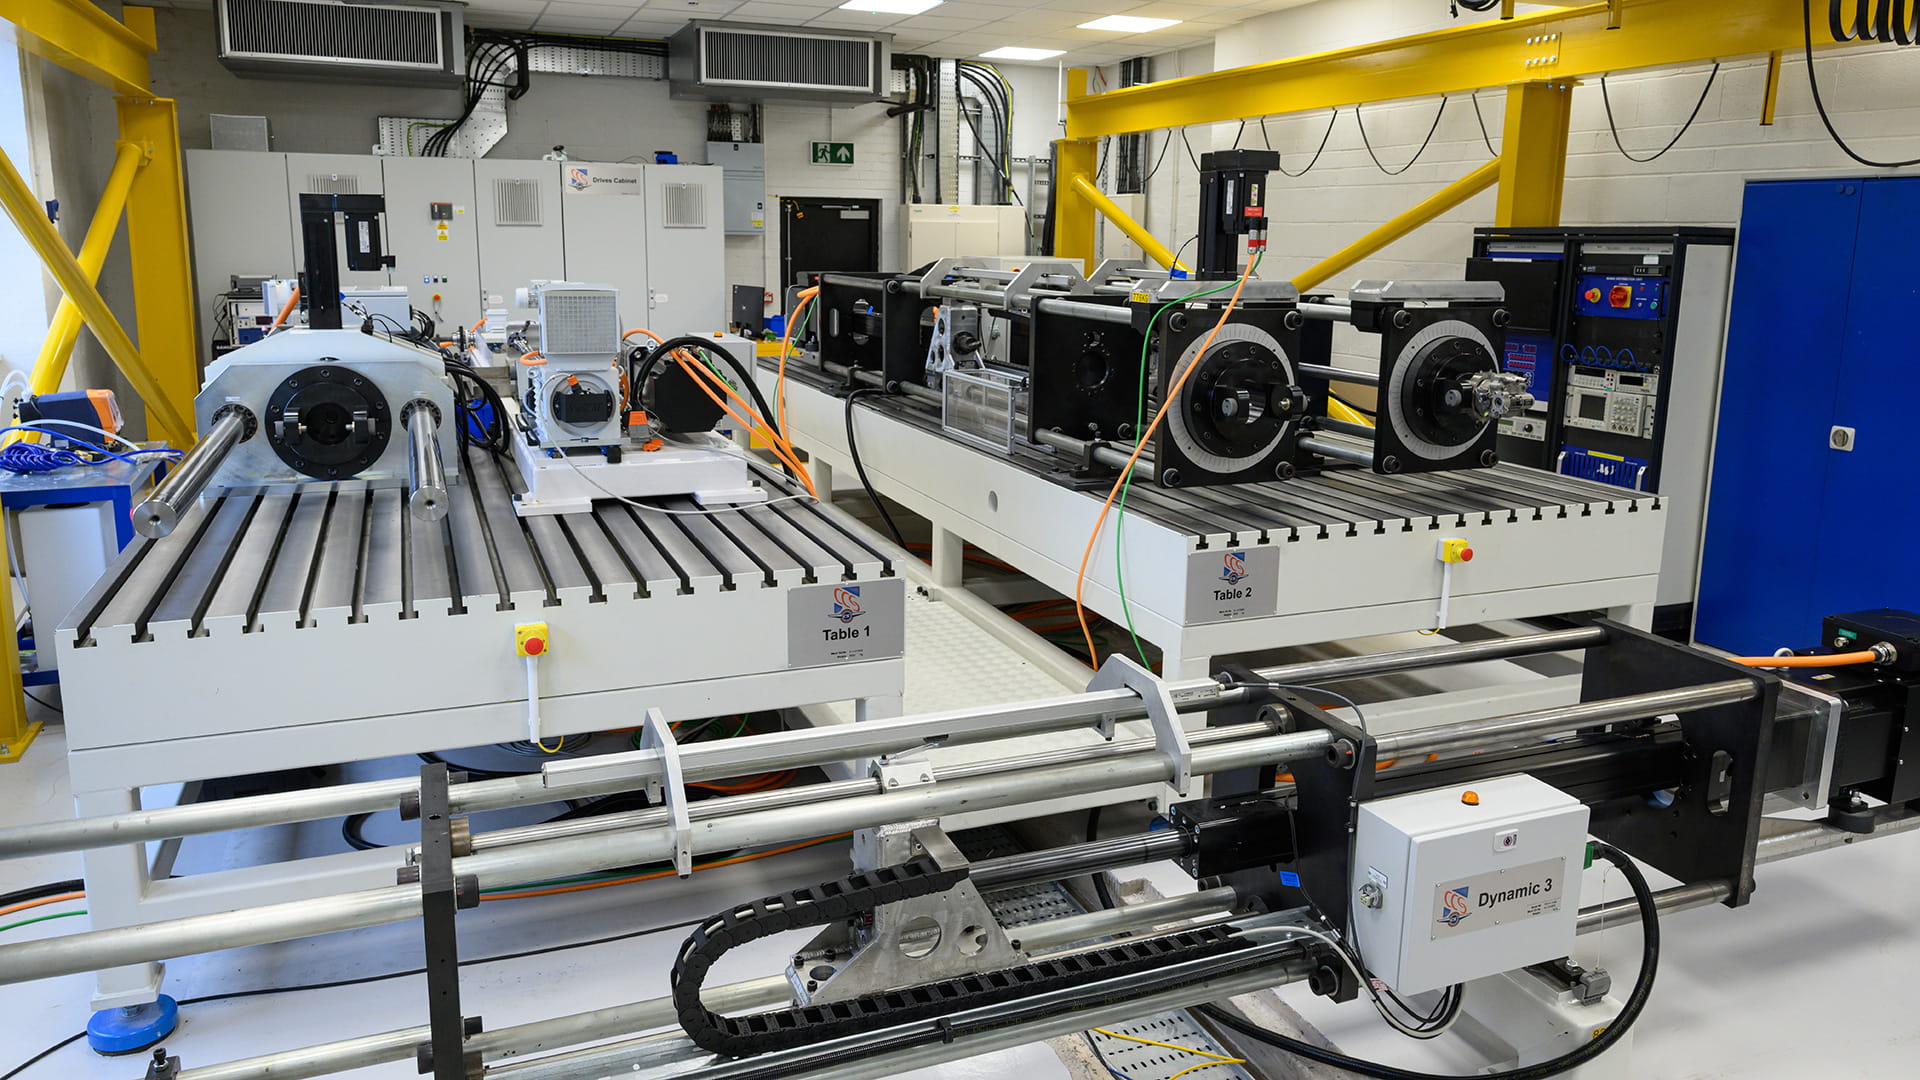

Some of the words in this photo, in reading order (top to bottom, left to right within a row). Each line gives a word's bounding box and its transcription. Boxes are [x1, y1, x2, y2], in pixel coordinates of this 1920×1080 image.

[1213, 588, 1242, 601] Table
[1245, 587, 1252, 597] 2
[822, 627, 859, 641] Table
[863, 625, 870, 637] 1
[1478, 882, 1541, 909] Dynamic
[1544, 878, 1553, 892] 3
